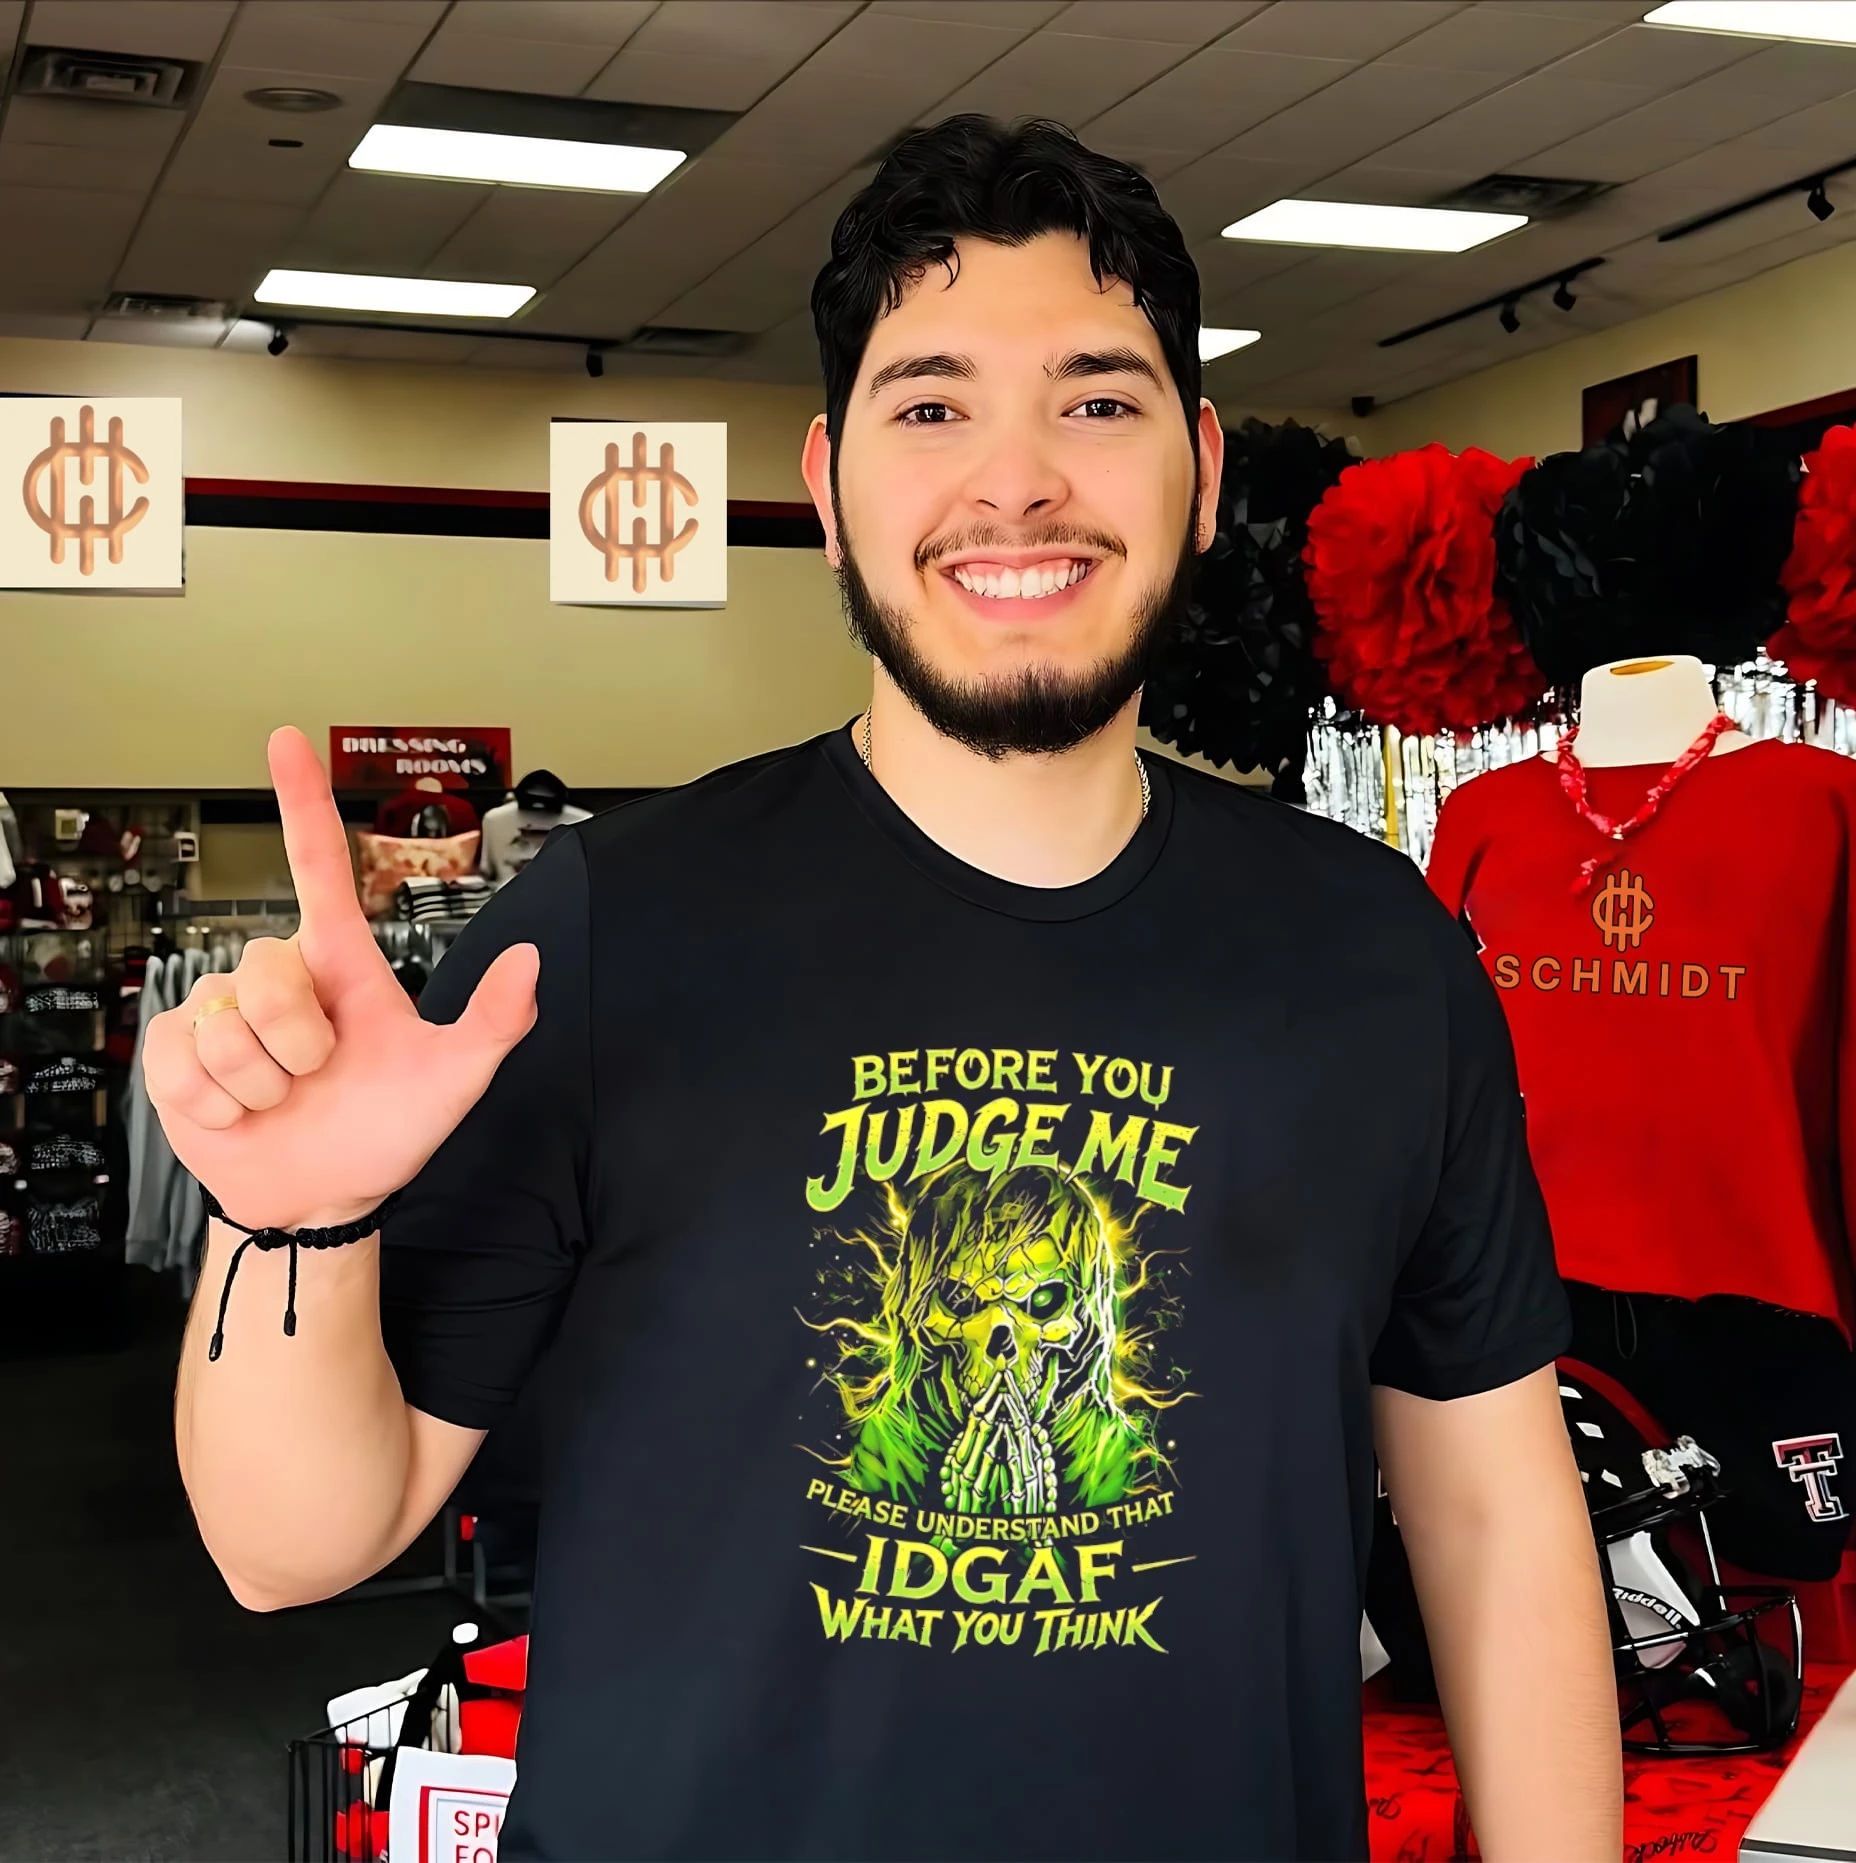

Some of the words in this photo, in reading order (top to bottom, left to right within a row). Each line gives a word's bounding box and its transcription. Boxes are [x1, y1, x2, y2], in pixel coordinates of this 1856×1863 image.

[396, 758, 487, 775] ROOMS
[1494, 954, 1747, 1000] SCHMIDT
[851, 1049, 1059, 1101] BEFORE
[1072, 1051, 1174, 1111] YOU
[805, 1098, 1072, 1213] JUDGE
[1066, 1110, 1200, 1214] ME
[806, 1478, 907, 1529] PLEASE
[916, 1510, 1099, 1540] UNDERSTAND
[1106, 1491, 1174, 1526] THAT
[855, 1533, 1124, 1604] IDGAF
[810, 1581, 942, 1647] WHAT
[951, 1608, 1024, 1654] YOU
[1033, 1597, 1169, 1656] THINK
